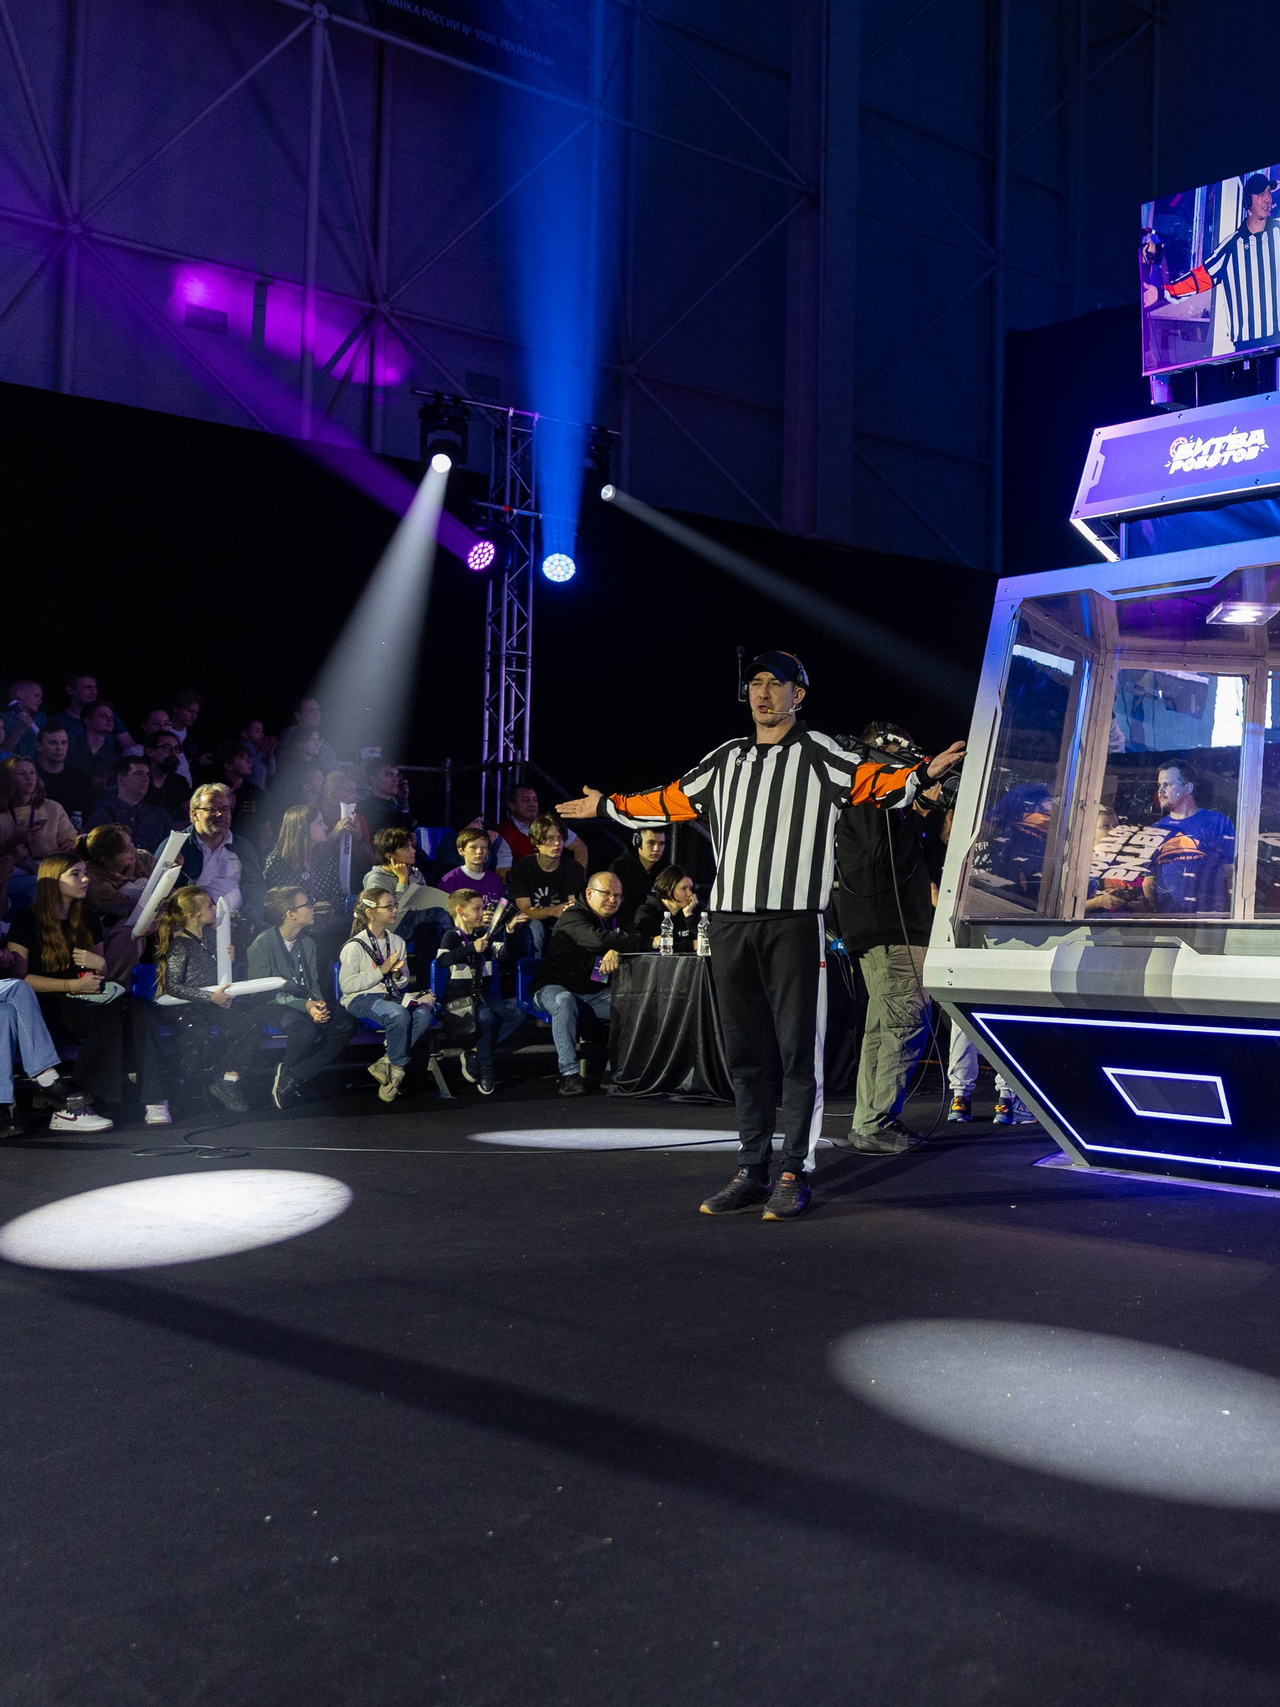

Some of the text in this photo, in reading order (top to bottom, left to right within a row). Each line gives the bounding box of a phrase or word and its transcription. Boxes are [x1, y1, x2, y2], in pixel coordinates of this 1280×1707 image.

[421, 7, 460, 33] РОССИИ
[500, 38, 542, 64] РЕКЛАМА
[1168, 446, 1261, 475] РОБОТОВ
[1173, 428, 1266, 461] БИТВА
